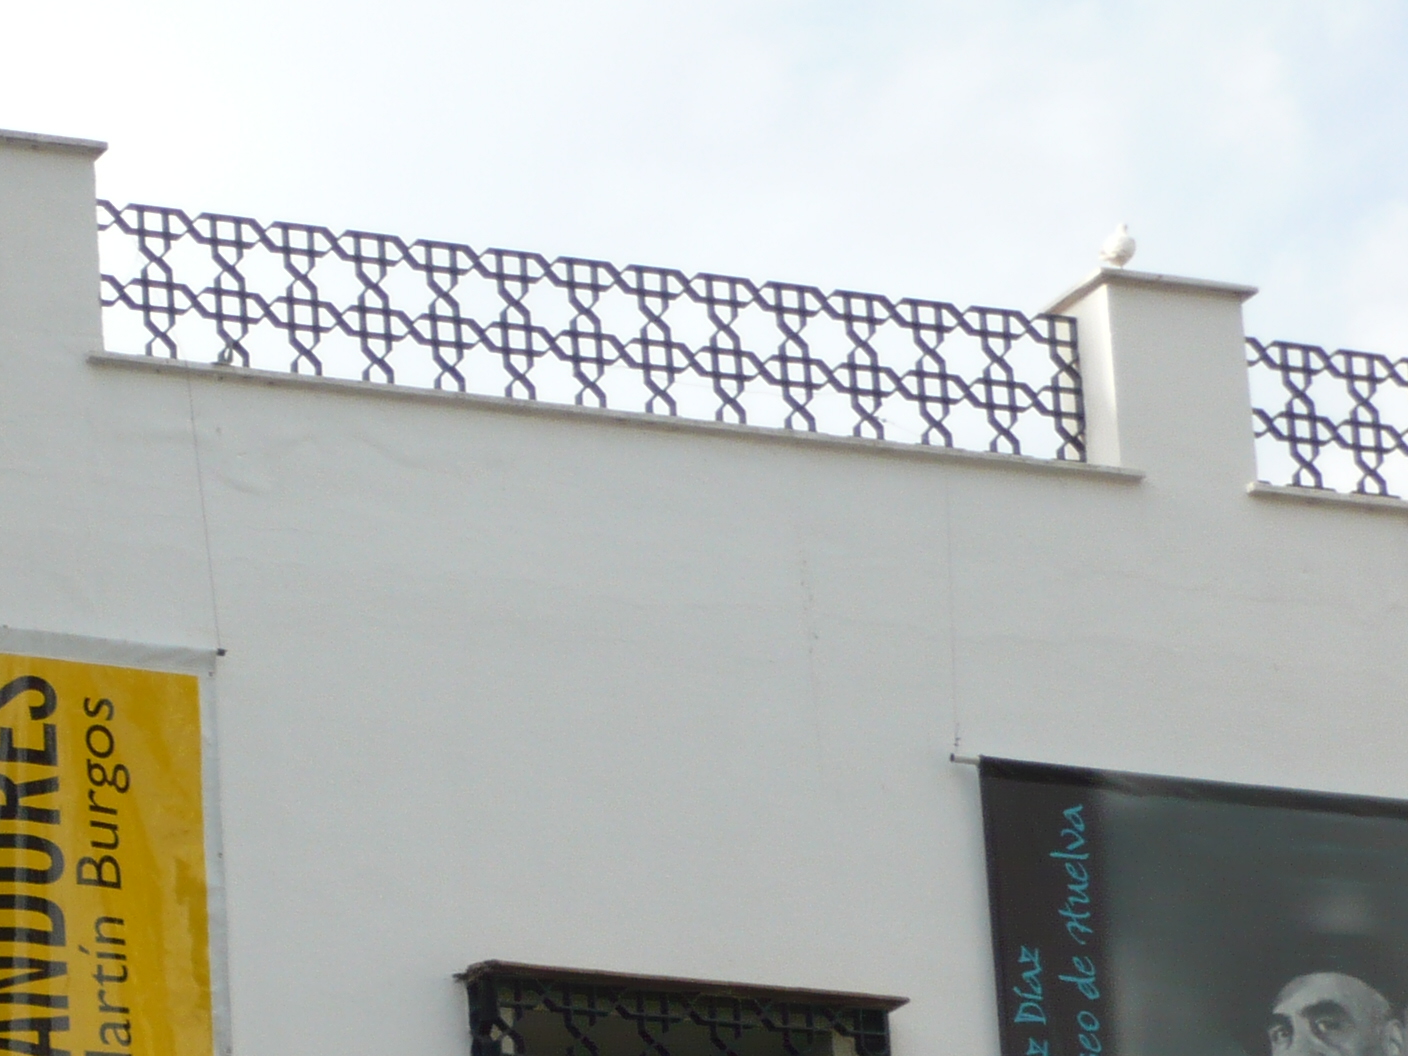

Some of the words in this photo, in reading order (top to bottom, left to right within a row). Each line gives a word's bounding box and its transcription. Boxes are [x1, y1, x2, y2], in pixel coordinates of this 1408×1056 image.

[76, 696, 130, 890] Burgos
[1049, 803, 1094, 945] Huelva
[1013, 945, 1048, 1025] Díaz
[1058, 955, 1100, 1000] de
